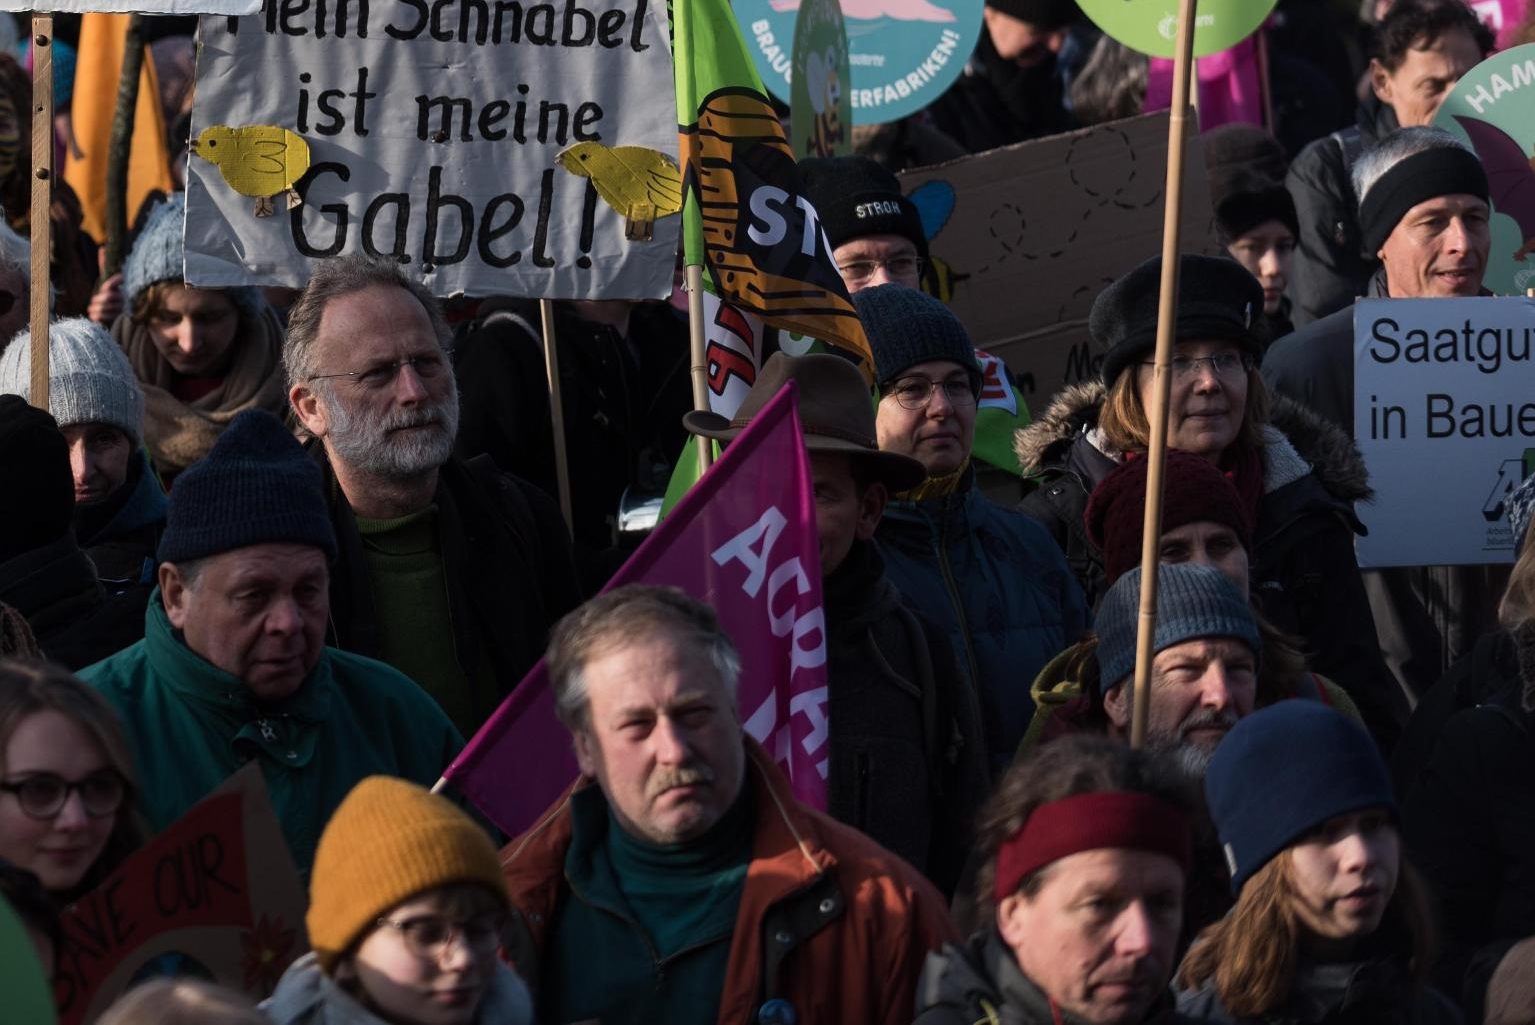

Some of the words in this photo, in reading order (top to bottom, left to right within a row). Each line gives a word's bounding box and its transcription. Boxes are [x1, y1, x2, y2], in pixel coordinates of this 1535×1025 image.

[295, 66, 377, 138] ist
[414, 83, 604, 144] meine
[850, 28, 961, 108] ERFABRIKEN!
[289, 161, 599, 274] Gabel!
[1370, 317, 1535, 374] Saatgu
[1371, 394, 1407, 440] in
[154, 833, 241, 918] OUR
